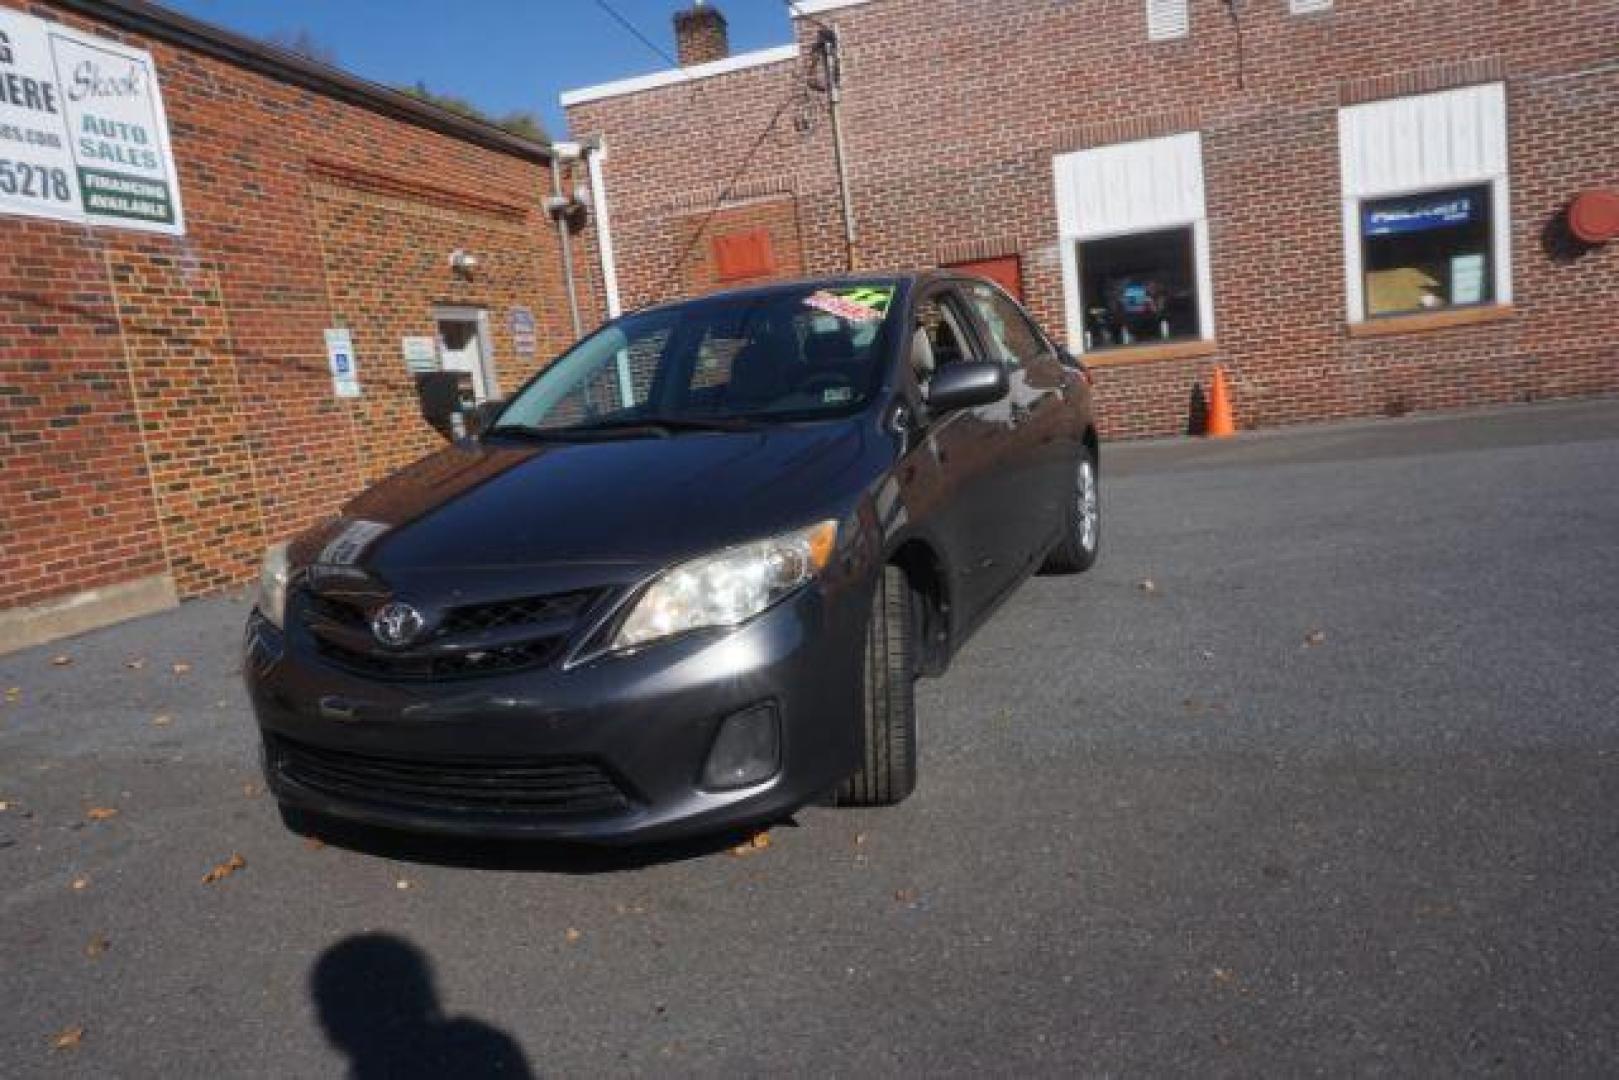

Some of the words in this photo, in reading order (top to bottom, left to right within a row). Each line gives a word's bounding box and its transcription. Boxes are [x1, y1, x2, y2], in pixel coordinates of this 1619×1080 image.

[82, 113, 148, 145] AUTO
[80, 138, 158, 169] SALES
[86, 174, 165, 198] FINANCING
[89, 194, 167, 217] AVAILABLE
